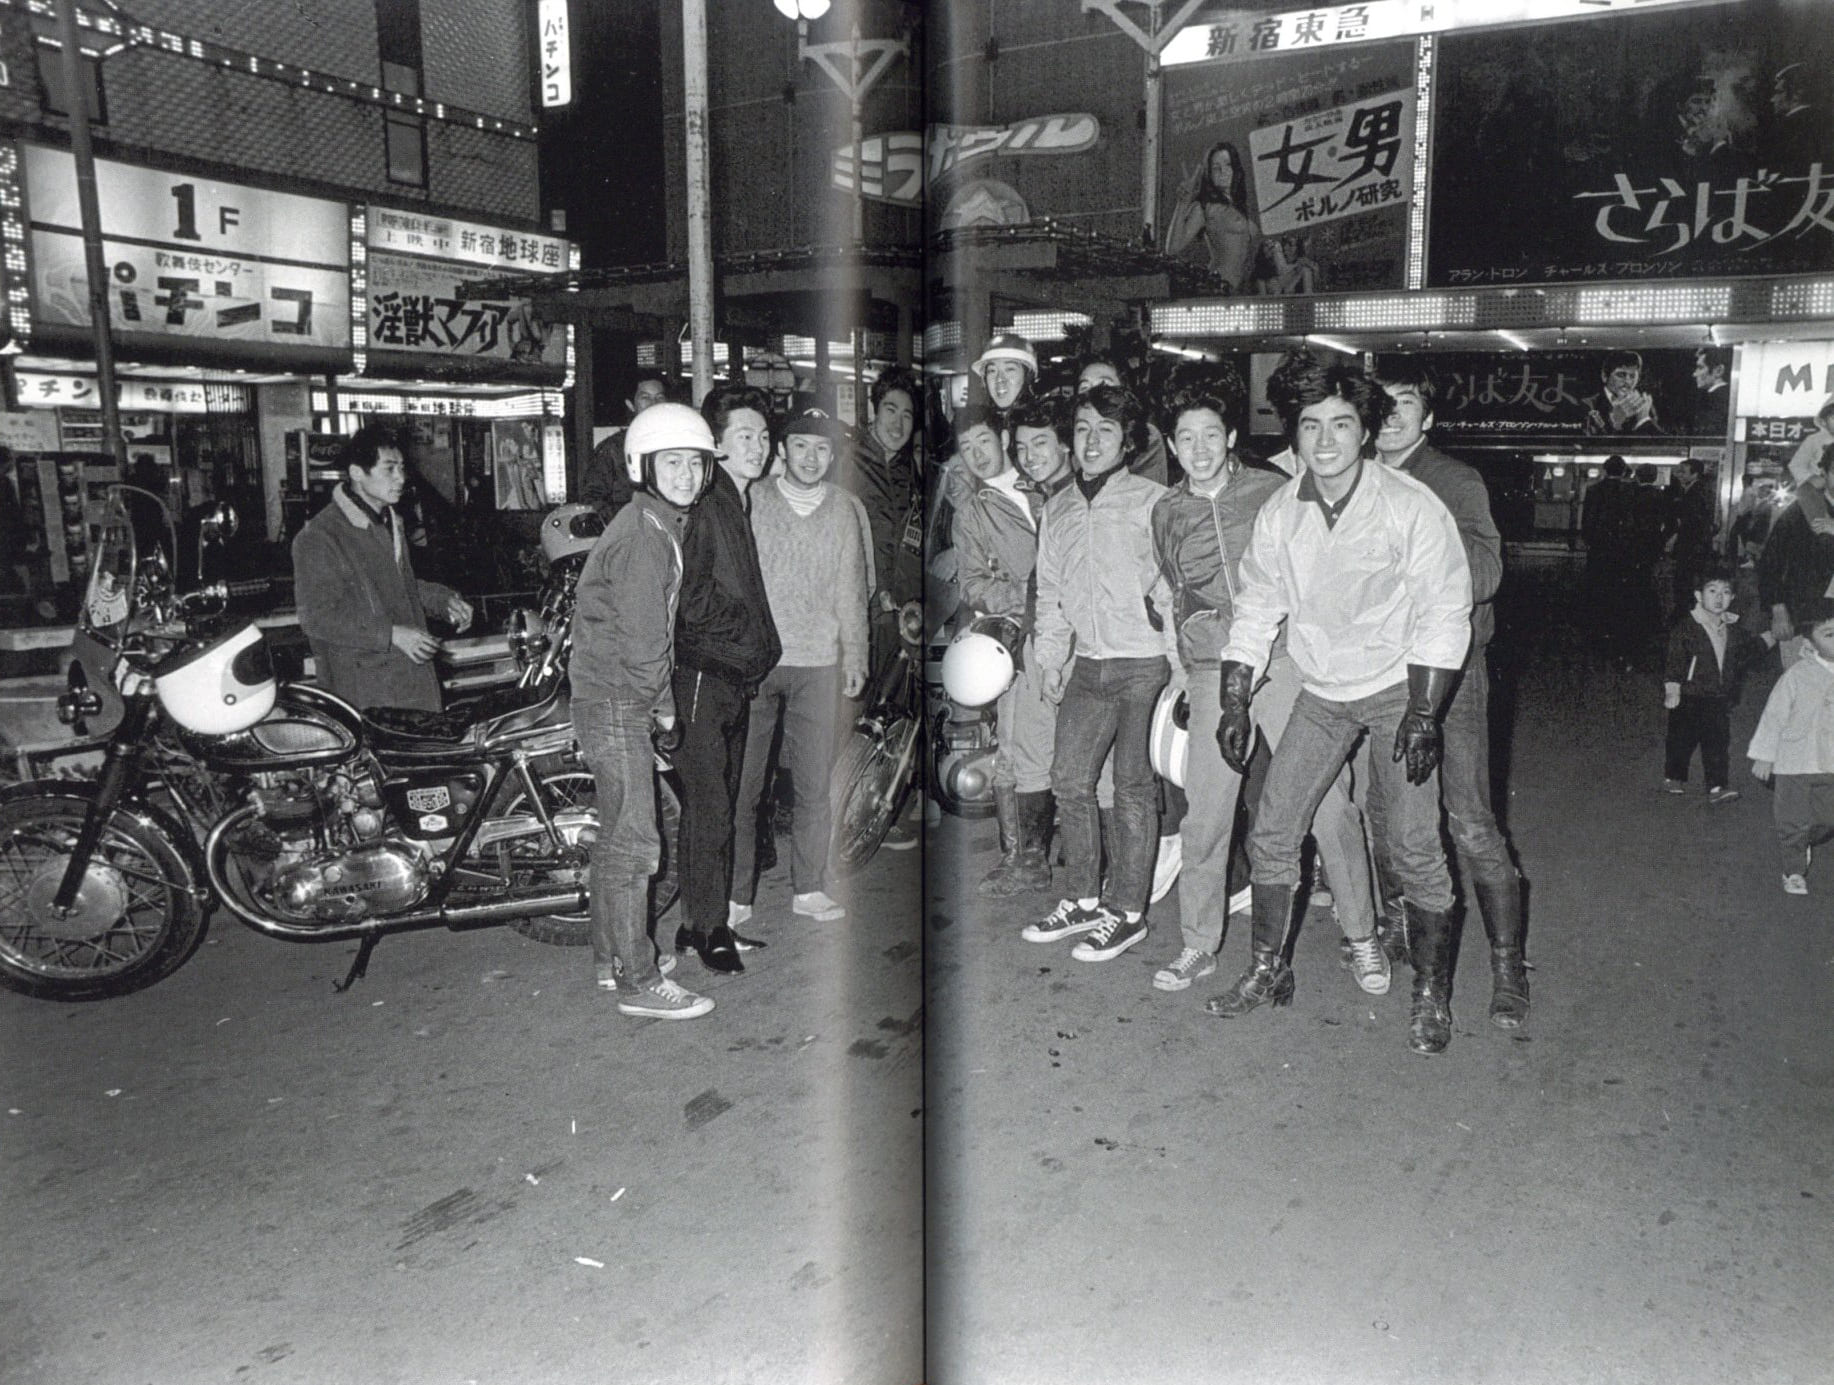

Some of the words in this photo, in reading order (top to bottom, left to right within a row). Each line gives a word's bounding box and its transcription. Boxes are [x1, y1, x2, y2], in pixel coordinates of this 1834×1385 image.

[1205, 6, 1369, 57] 新宿東急
[155, 252, 254, 276] 歌舞伎センター
[461, 230, 561, 269] 新宿地球座
[372, 291, 512, 355] 淫獣マフィア
